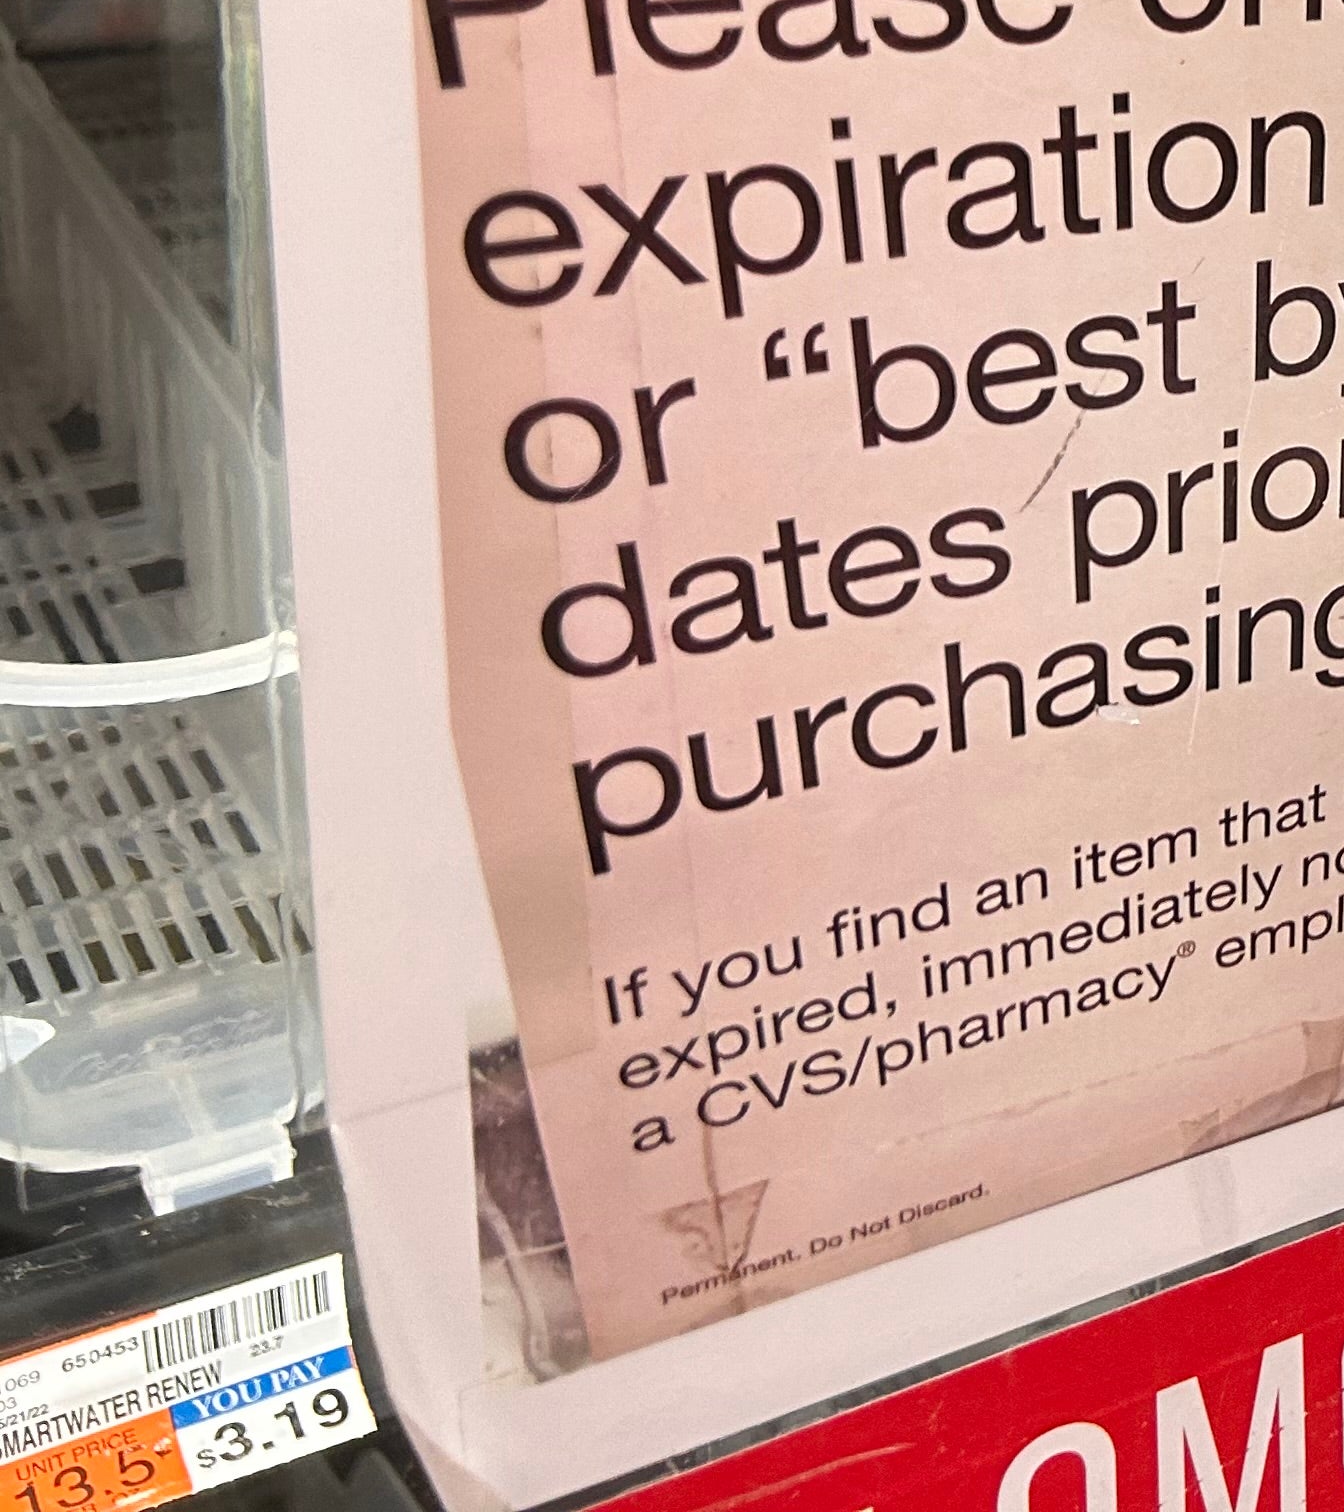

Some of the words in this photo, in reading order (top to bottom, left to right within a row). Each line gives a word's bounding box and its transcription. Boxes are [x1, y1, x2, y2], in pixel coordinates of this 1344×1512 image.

[463, 92, 1326, 320] expiration
[504, 377, 696, 504] or
[763, 281, 1197, 450] “best
[541, 507, 1012, 678] dates
[604, 966, 648, 1025] If
[672, 936, 803, 1018] you
[826, 881, 951, 959] find
[976, 866, 1050, 917] an
[1073, 825, 1198, 890] item
[1218, 783, 1327, 848] that
[619, 971, 898, 1090] expired,
[922, 863, 1283, 998] immediately
[632, 1114, 676, 1153] a
[661, 1248, 801, 1305] Permanent.
[810, 1235, 843, 1256] Do
[850, 1216, 892, 1241] Not
[899, 1183, 991, 1225] Discard.
[0, 1389, 142, 1460] MARTWATER
[146, 1358, 223, 1409] RENEW
[61, 1336, 139, 1373] 650453
[191, 1378, 263, 1420] YOU
[270, 1355, 325, 1393] PAY
[16, 1450, 66, 1482] UNIT
[72, 1427, 138, 1464] PRICE
[196, 1387, 350, 1469] $3.19
